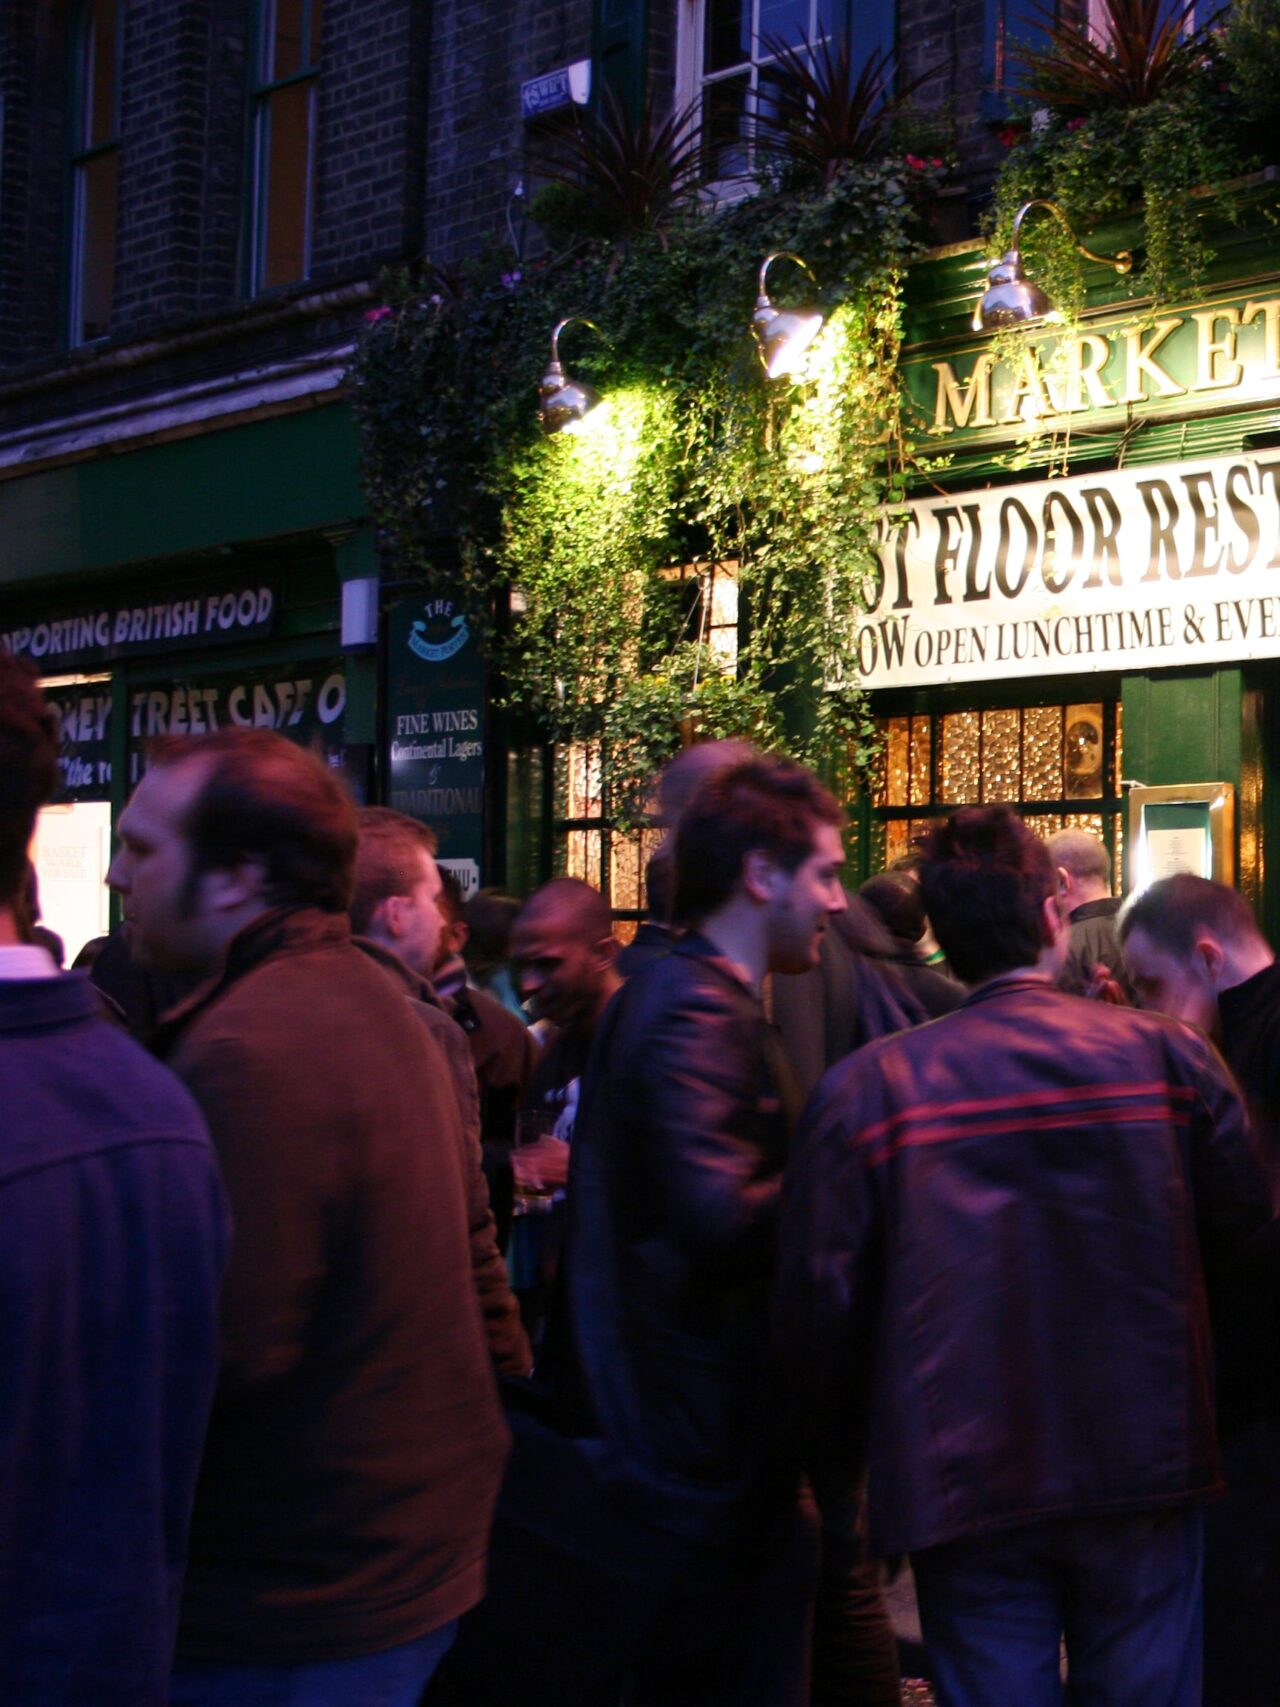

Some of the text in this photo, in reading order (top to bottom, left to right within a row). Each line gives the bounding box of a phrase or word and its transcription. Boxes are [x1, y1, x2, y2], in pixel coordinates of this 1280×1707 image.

[930, 487, 1123, 606] FLOOR
[114, 600, 200, 644] BRITISH
[205, 588, 273, 631] FOOD
[424, 599, 453, 618] THE
[850, 615, 910, 678] OW
[914, 625, 988, 668] OPEN
[995, 606, 1175, 661] LUNCHTIME
[1183, 604, 1206, 645] &
[131, 687, 219, 737] TREET
[396, 709, 478, 736] FINE WINES
[390, 735, 483, 762] Continental Lagers
[42, 846, 88, 858] BASKET
